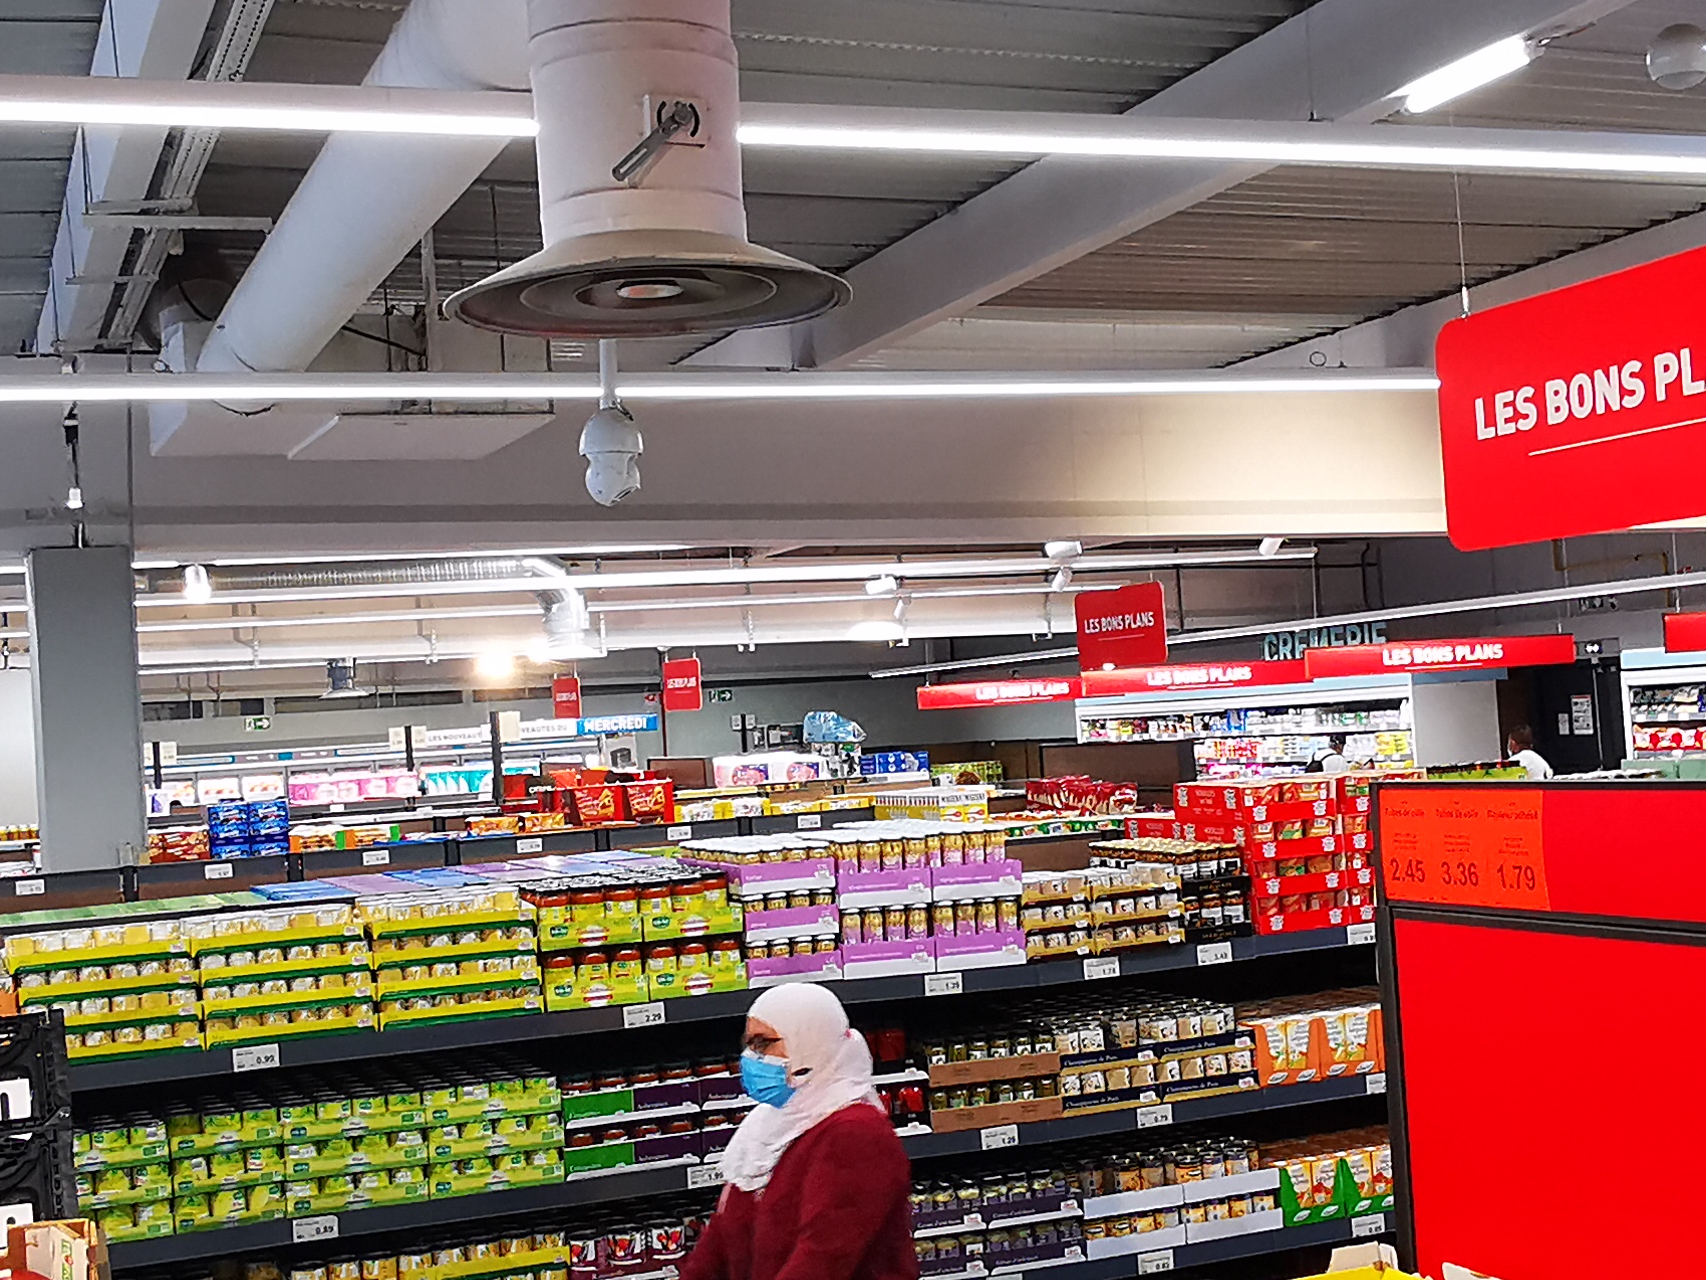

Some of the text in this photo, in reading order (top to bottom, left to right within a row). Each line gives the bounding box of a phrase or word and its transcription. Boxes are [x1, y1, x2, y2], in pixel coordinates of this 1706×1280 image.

[1475, 386, 1538, 441] LES
[1545, 359, 1646, 426] BONS
[1084, 610, 1155, 634] LES BONS PLANS
[1382, 641, 1503, 667] LES BONS PLANS
[1147, 671, 1174, 687] LES
[1211, 665, 1252, 683] PLANS
[584, 716, 647, 733] MERCREDI
[1390, 858, 1426, 884] 2.45
[1441, 860, 1479, 887] 3.36
[1497, 864, 1536, 891] 1.79
